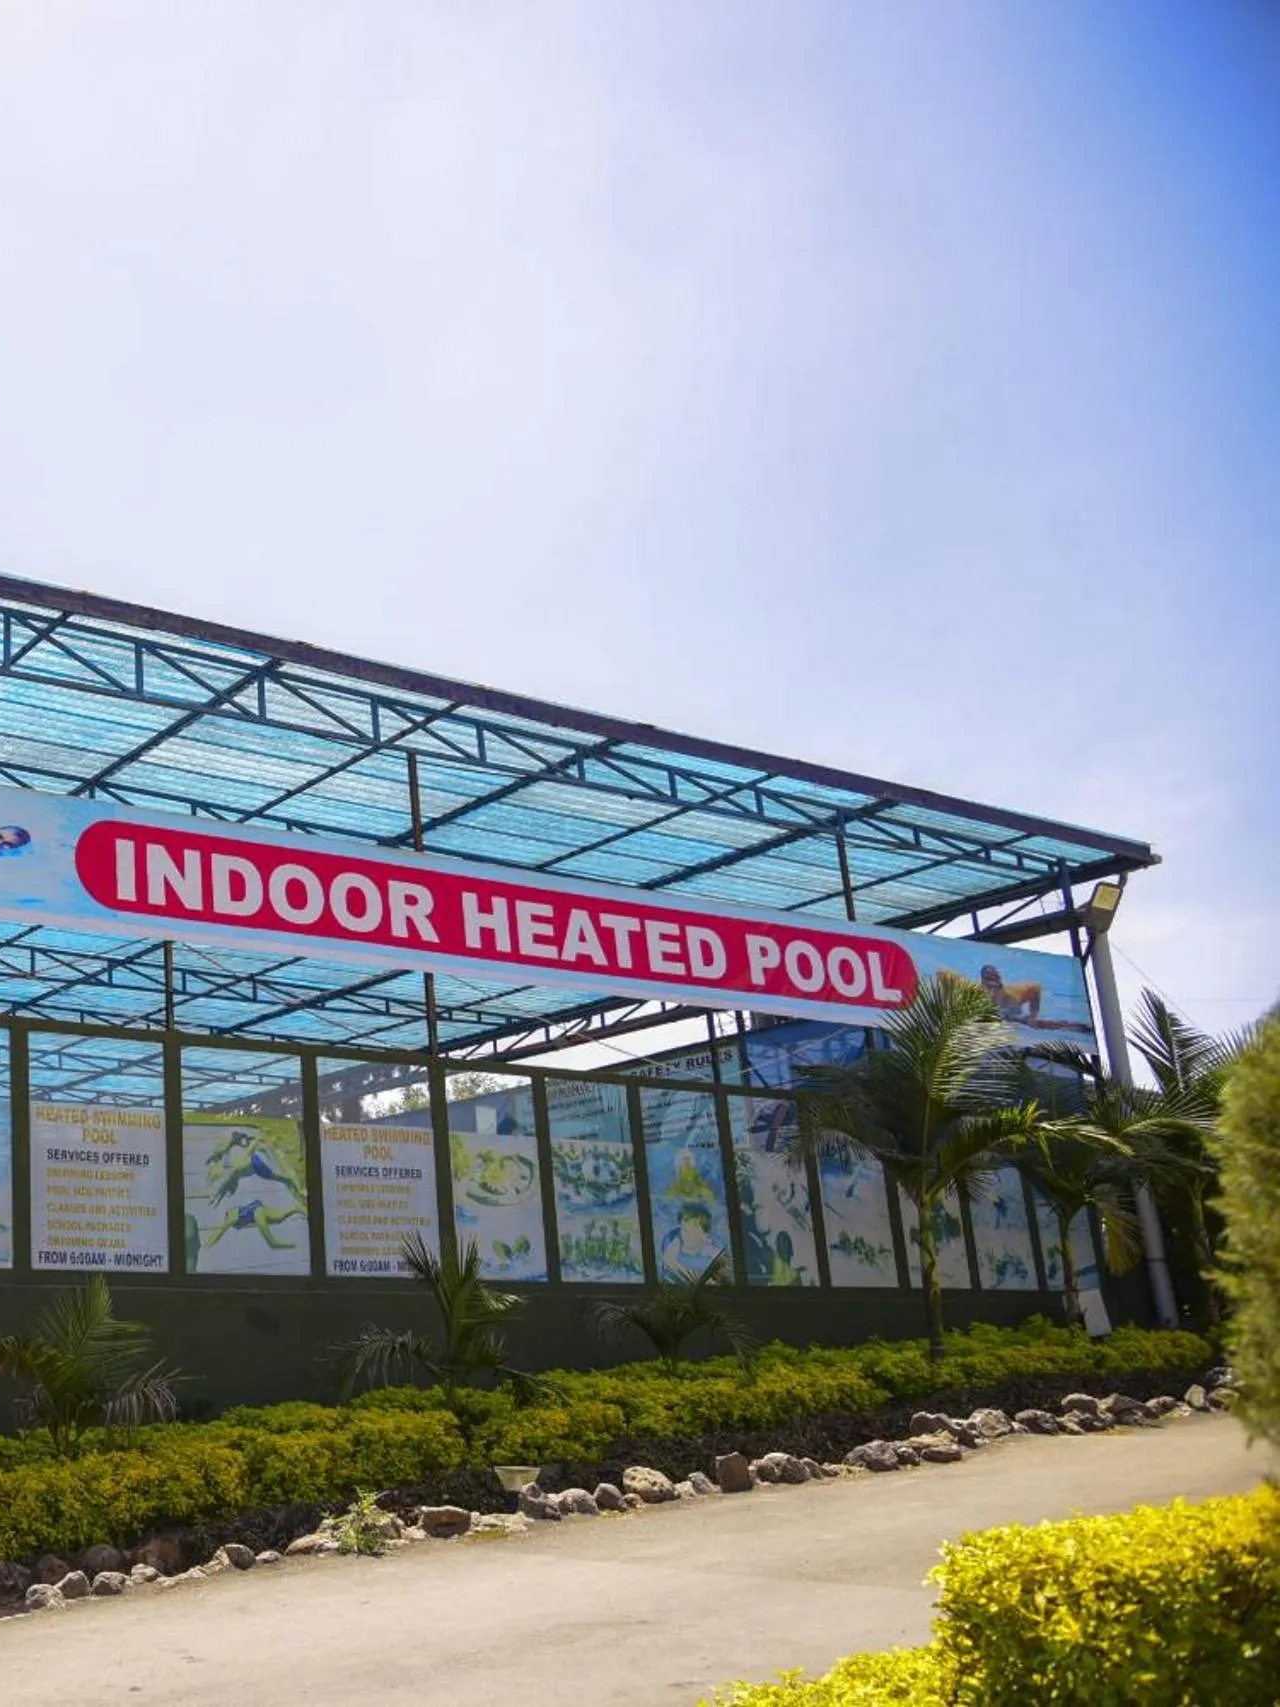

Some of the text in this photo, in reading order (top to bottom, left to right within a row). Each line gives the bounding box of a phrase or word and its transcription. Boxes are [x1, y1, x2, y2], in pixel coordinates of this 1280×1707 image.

[115, 838, 903, 1001] INDOOR HEATED POOL
[323, 1126, 368, 1142] HEATED
[47, 1148, 149, 1166] SERVICES OFFERED
[335, 1165, 422, 1180] SERVICES OFFERED
[39, 1251, 67, 1265] FROM
[114, 1253, 163, 1268] MIDNIGHT
[334, 1260, 358, 1273] FROM
